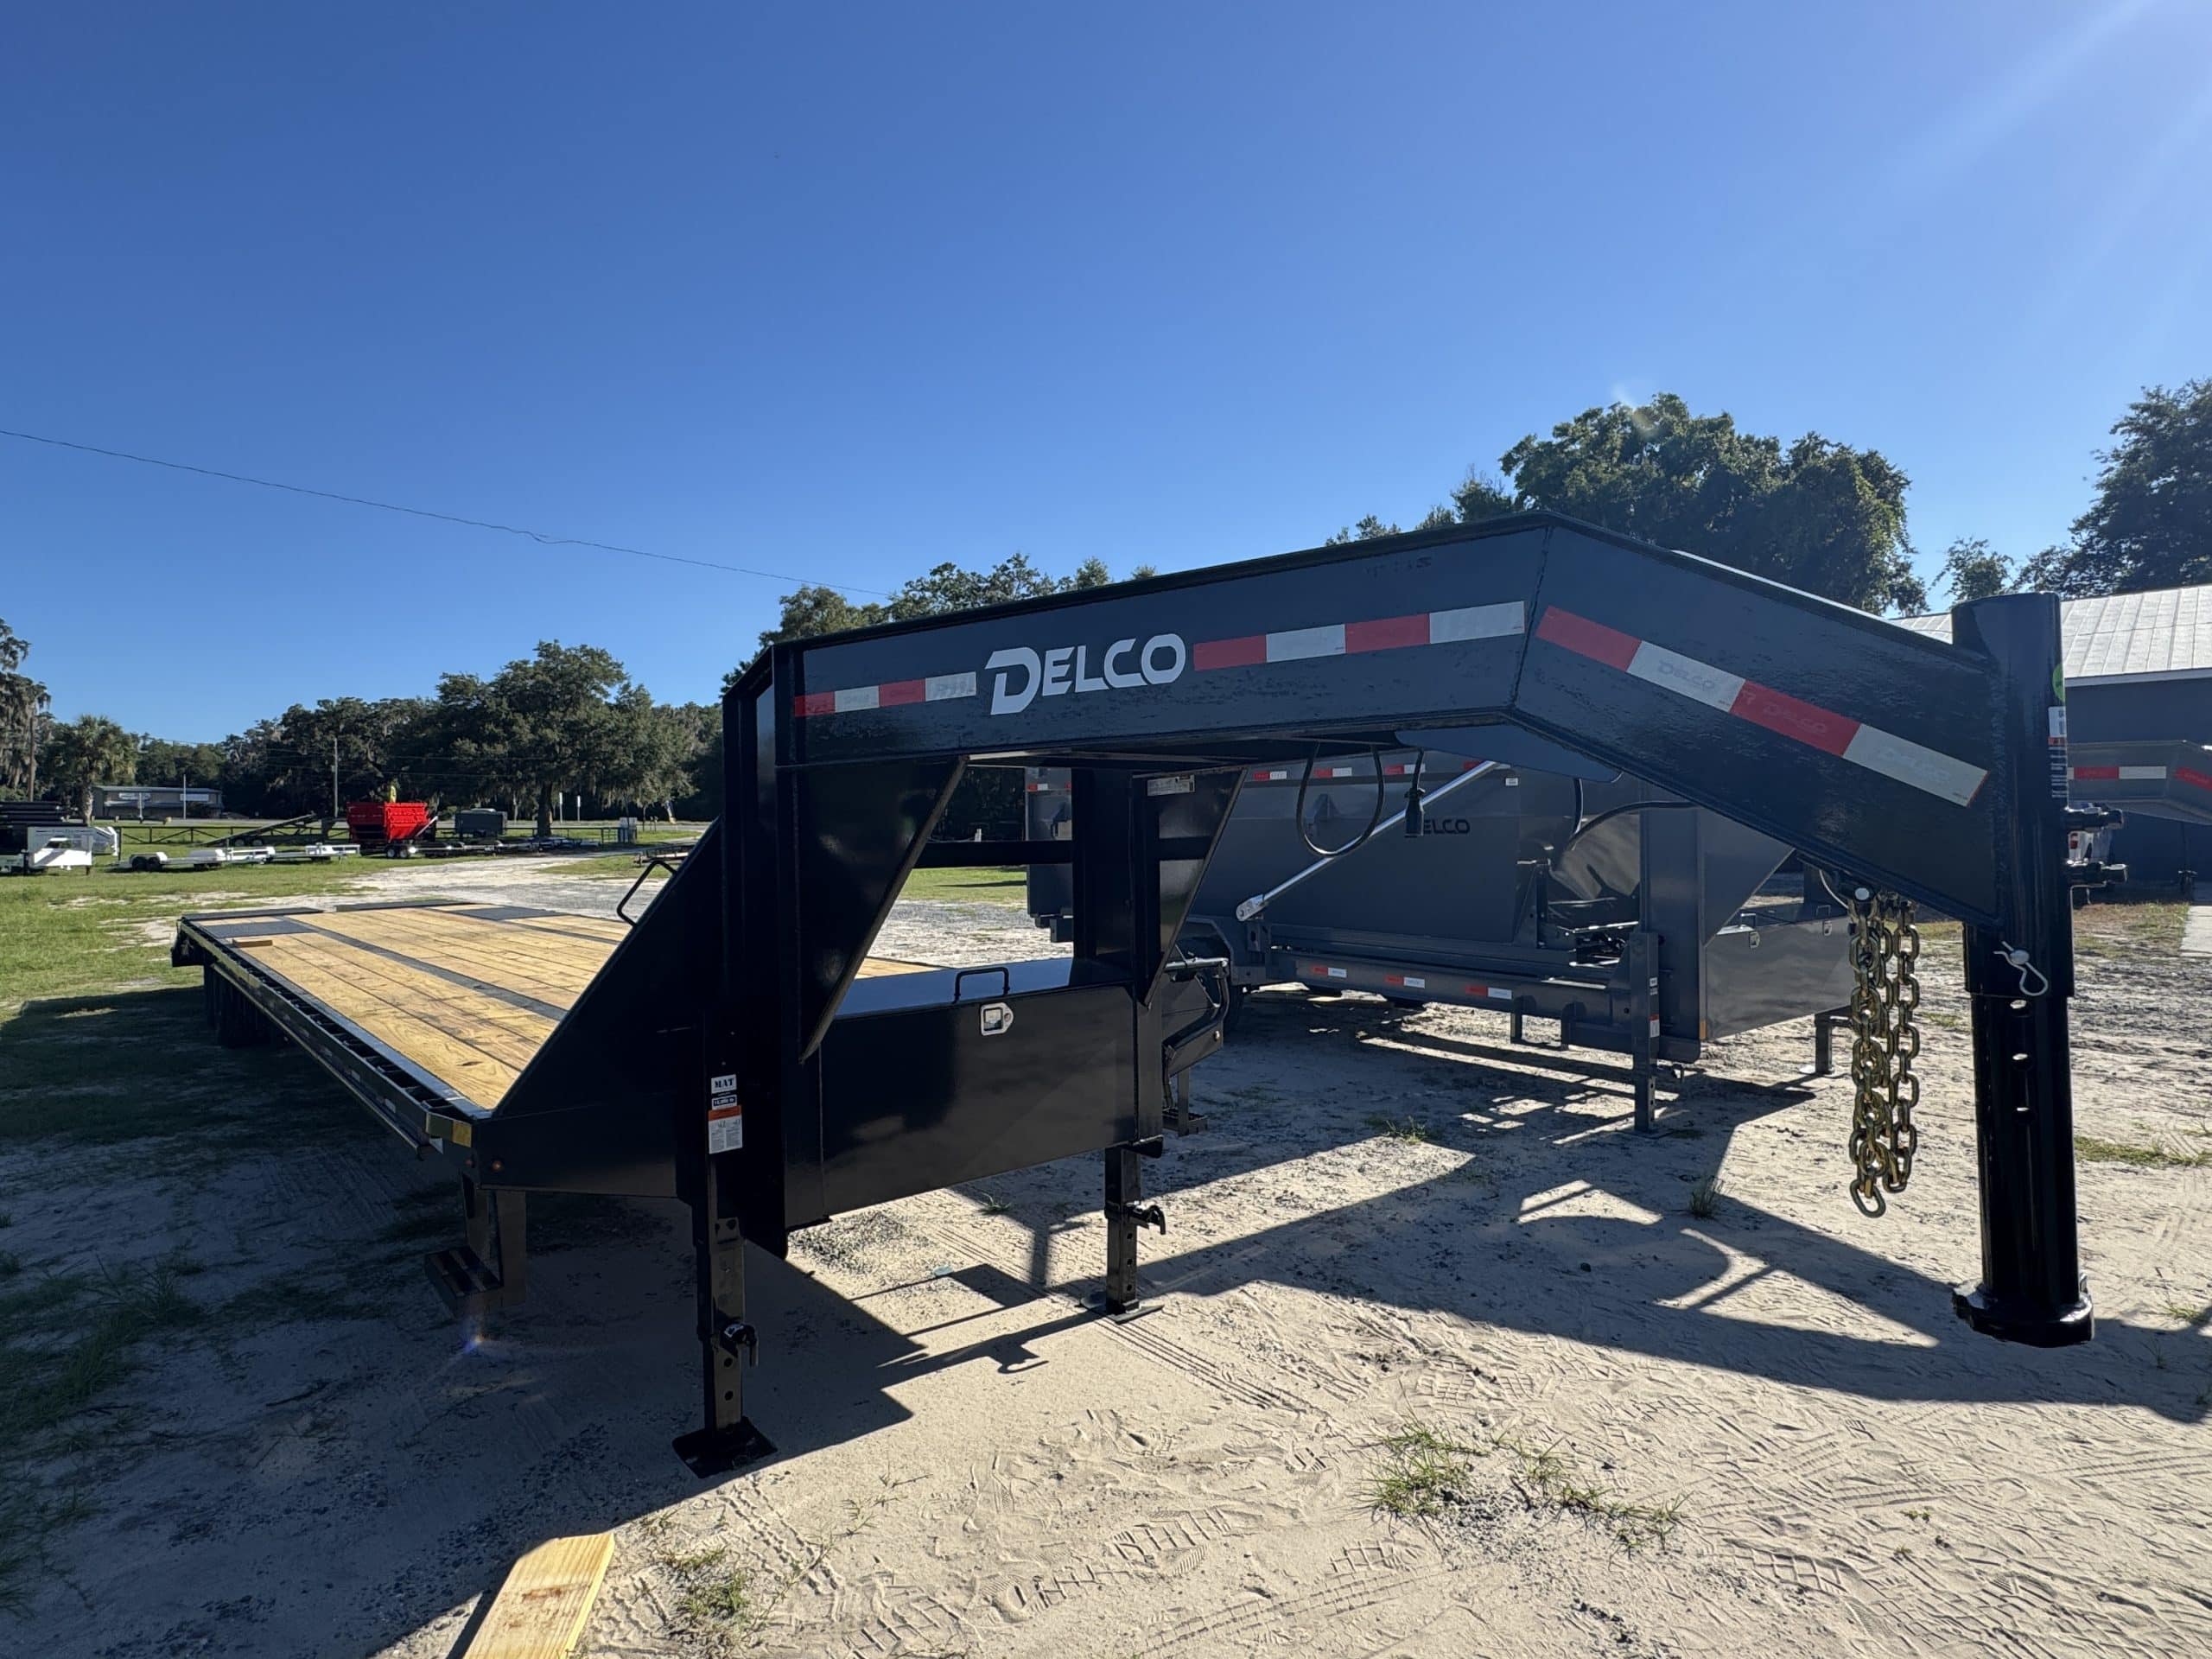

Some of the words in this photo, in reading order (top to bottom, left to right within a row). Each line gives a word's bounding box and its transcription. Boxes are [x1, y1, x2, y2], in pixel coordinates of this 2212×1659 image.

[985, 633, 1186, 715] DELCO
[1423, 819, 1471, 835] ELCO
[715, 1077, 734, 1089] MAT
